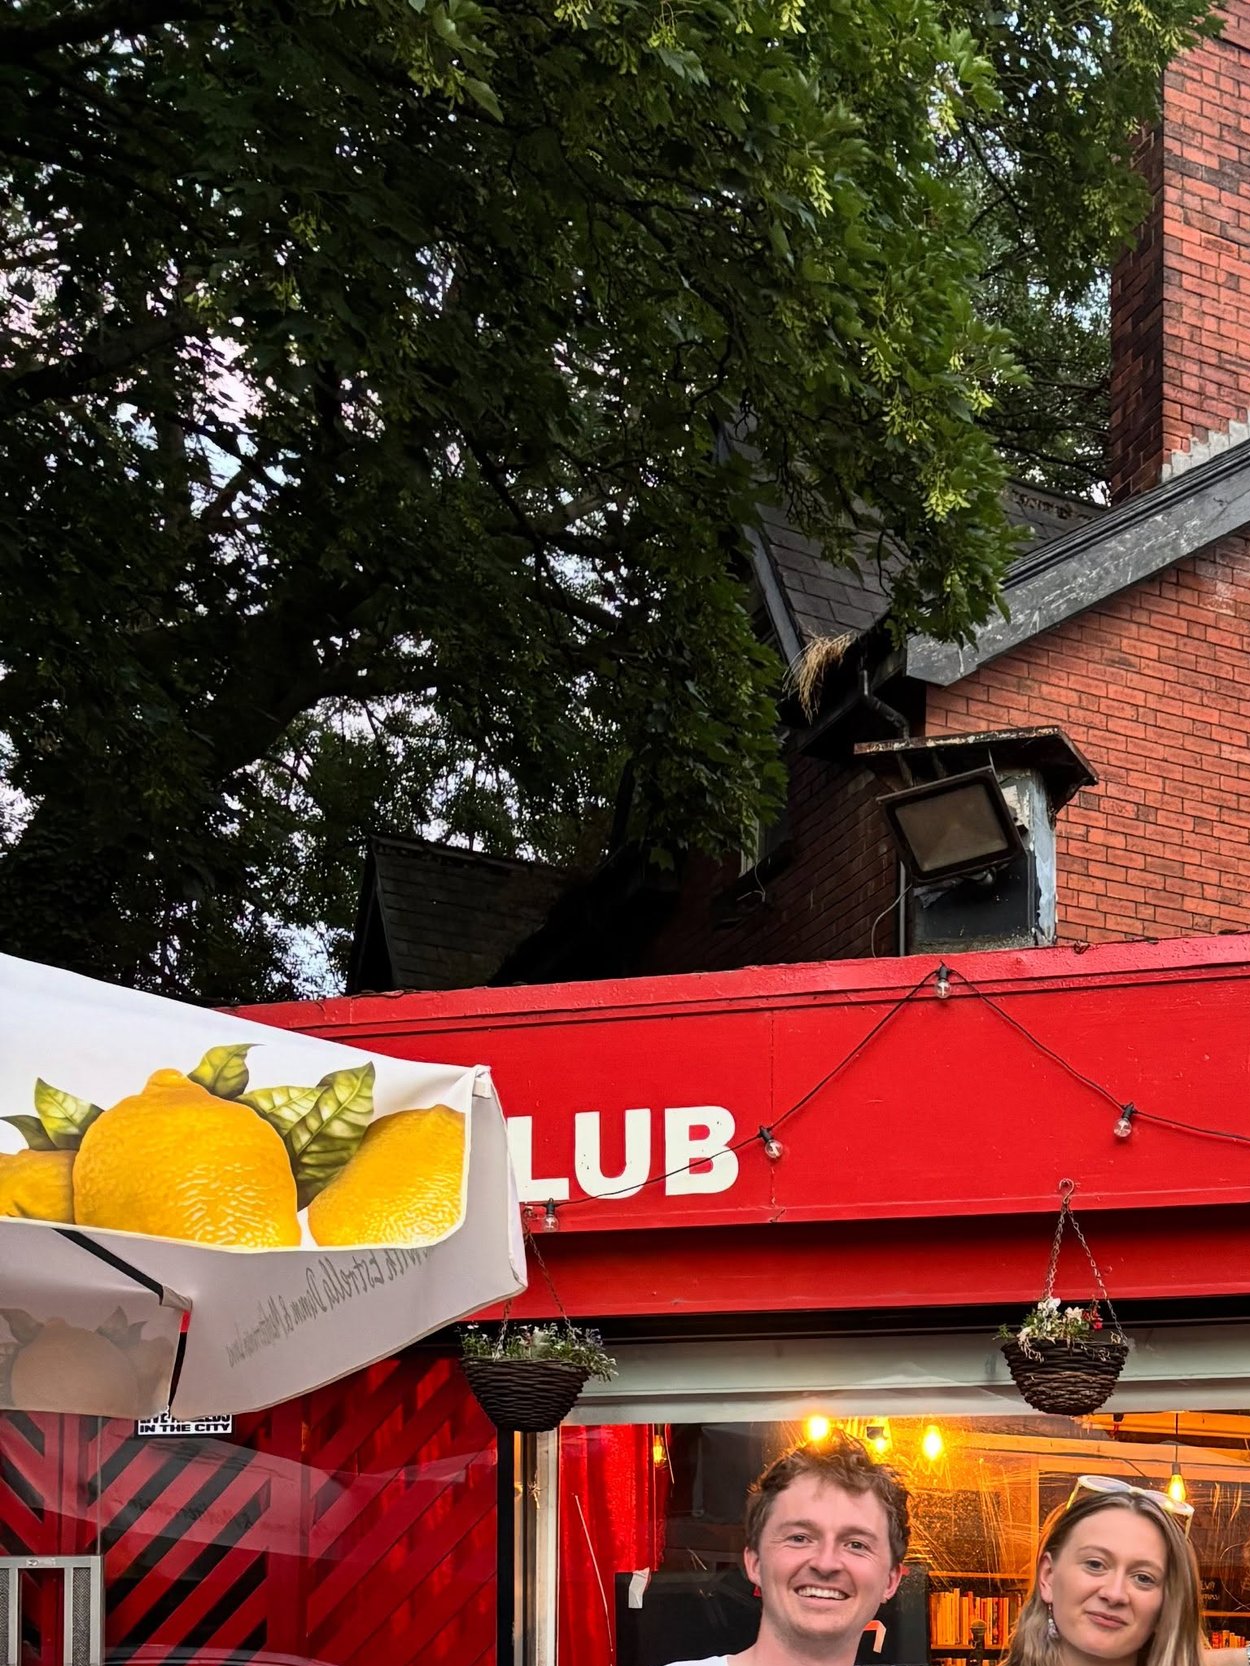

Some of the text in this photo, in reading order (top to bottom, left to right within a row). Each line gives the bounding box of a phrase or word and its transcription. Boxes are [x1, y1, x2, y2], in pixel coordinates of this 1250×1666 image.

[140, 1423, 230, 1433] IN THE CITY
